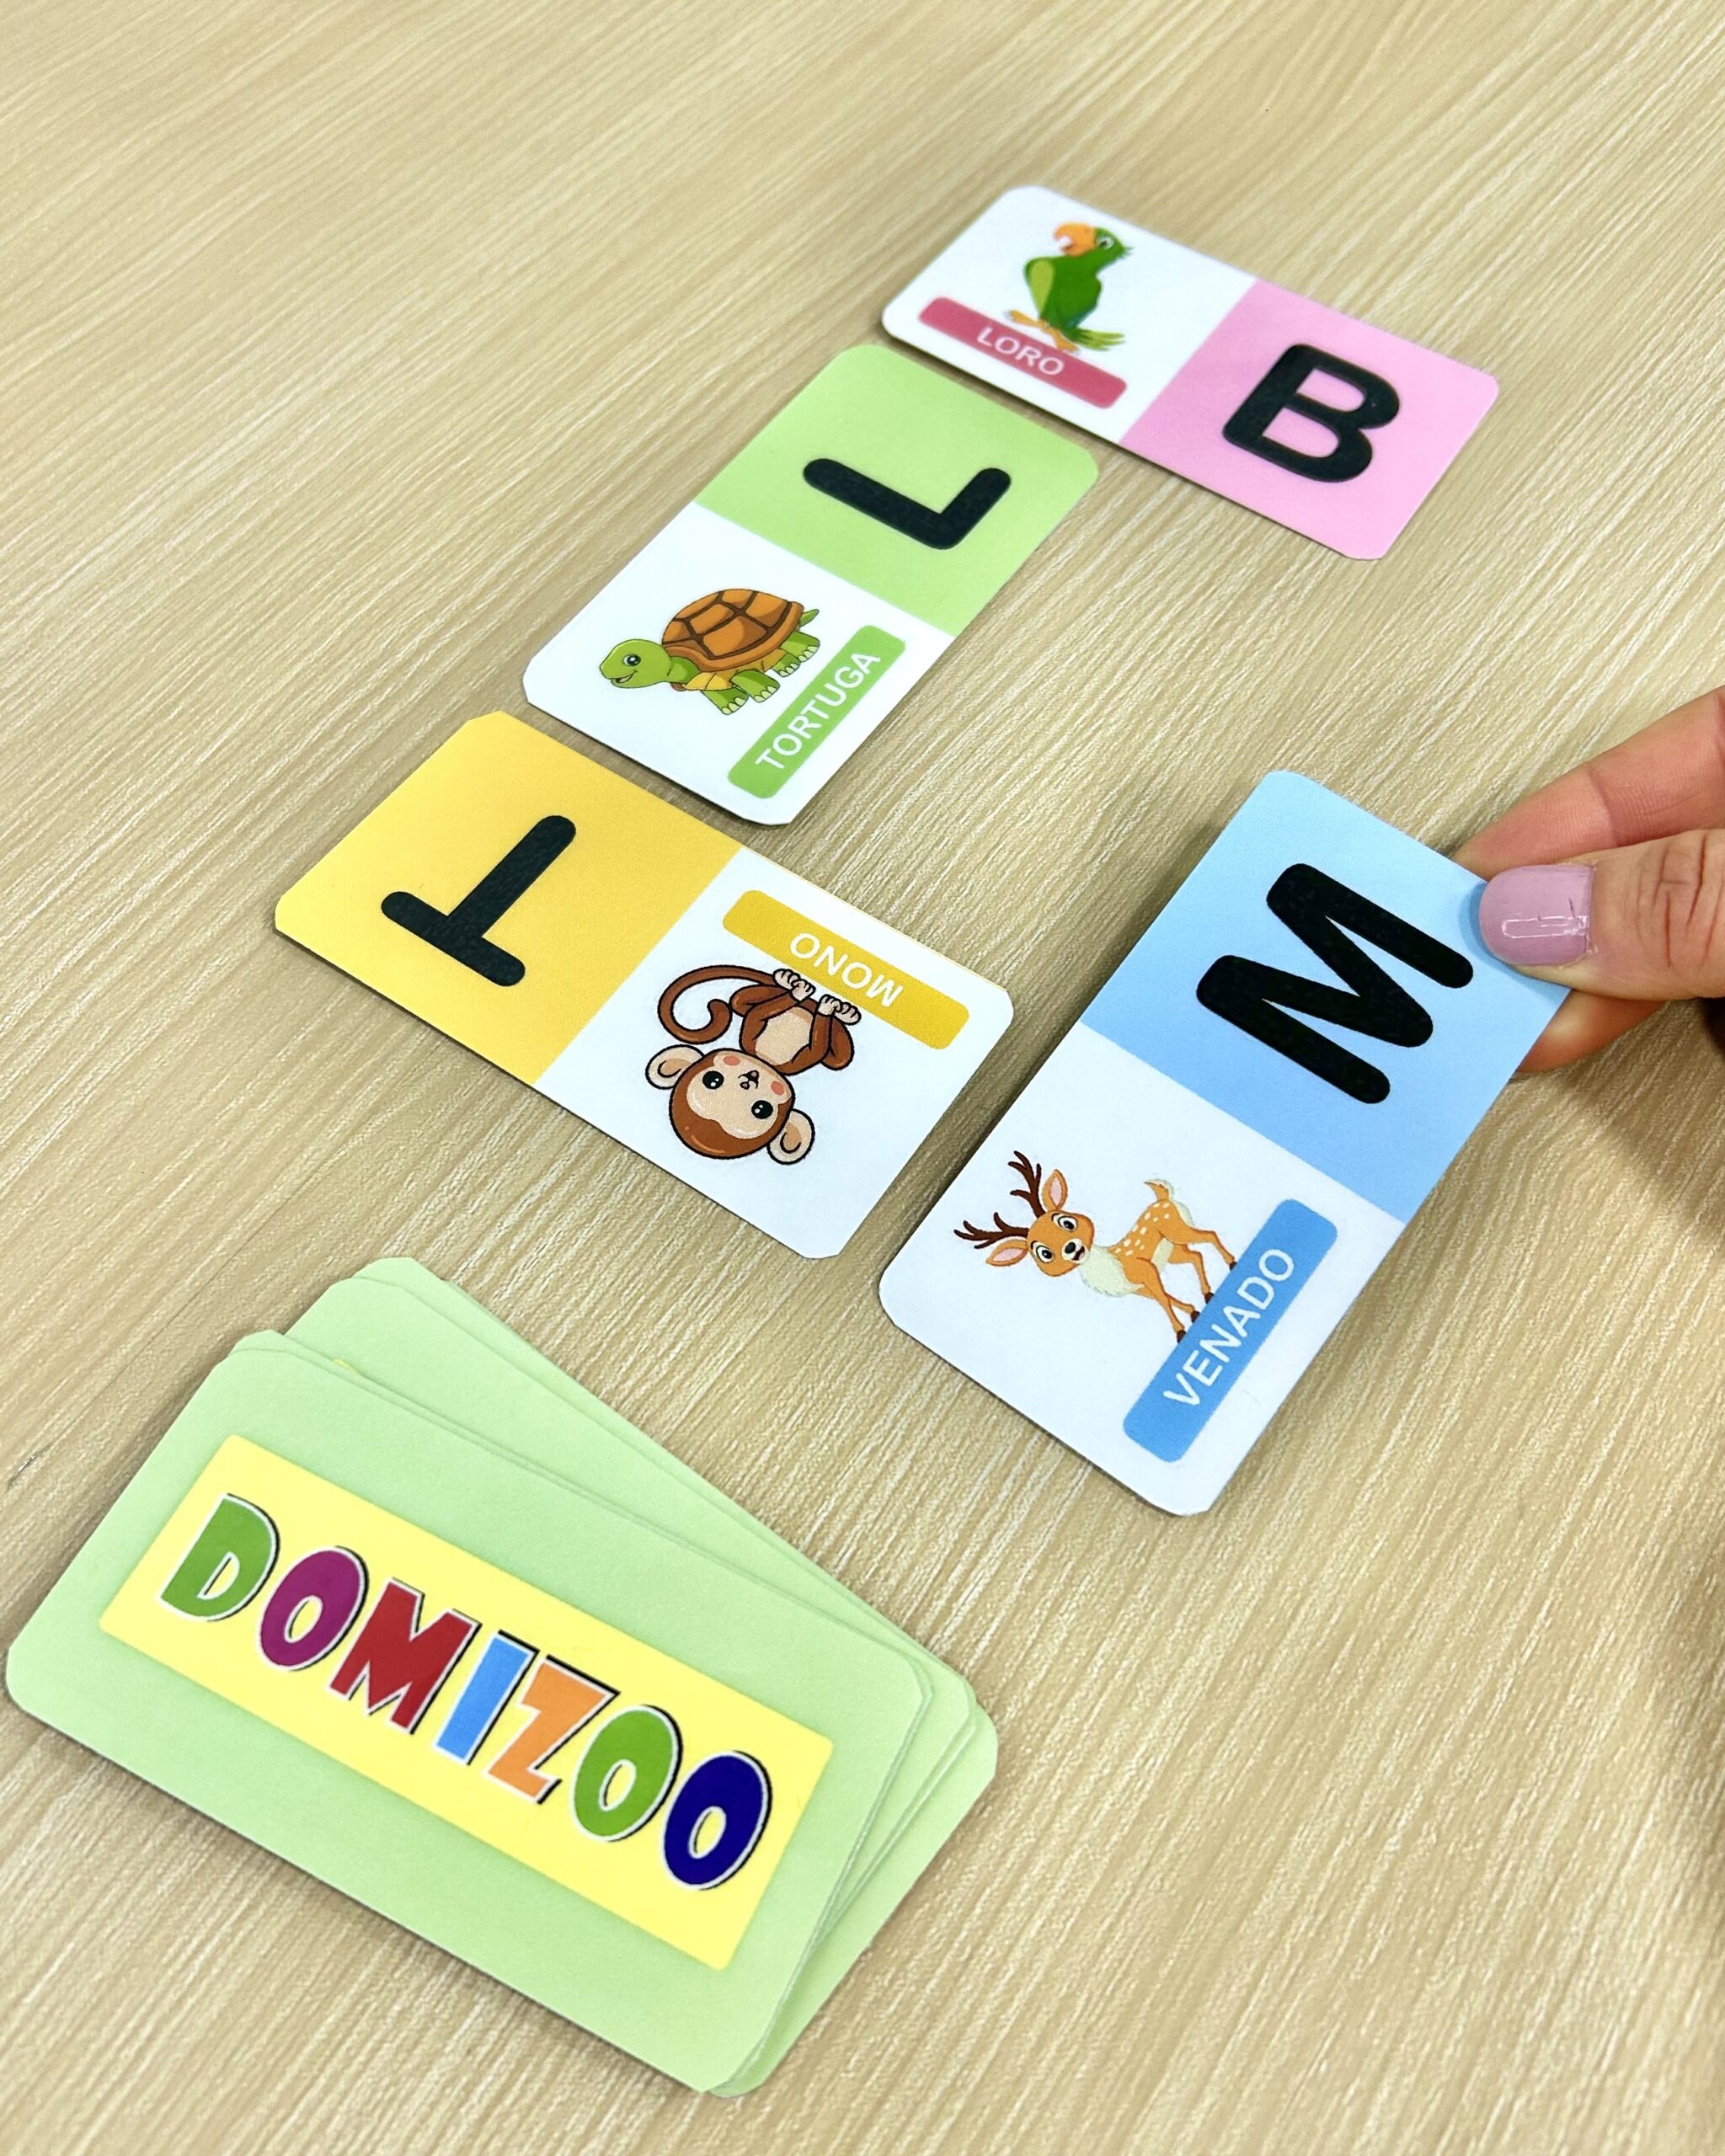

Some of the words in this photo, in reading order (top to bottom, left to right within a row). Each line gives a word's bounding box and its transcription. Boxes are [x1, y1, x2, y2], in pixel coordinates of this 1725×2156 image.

[975, 325, 1065, 376] LORO
[1222, 344, 1400, 483] B
[803, 457, 1012, 550] L
[756, 651, 881, 770] TORTUGA
[381, 814, 576, 988] T
[789, 931, 904, 1008] MONO
[1196, 862, 1474, 1105] M
[1162, 1247, 1295, 1406] VENADO
[158, 1492, 773, 1892] DOMIZOO
